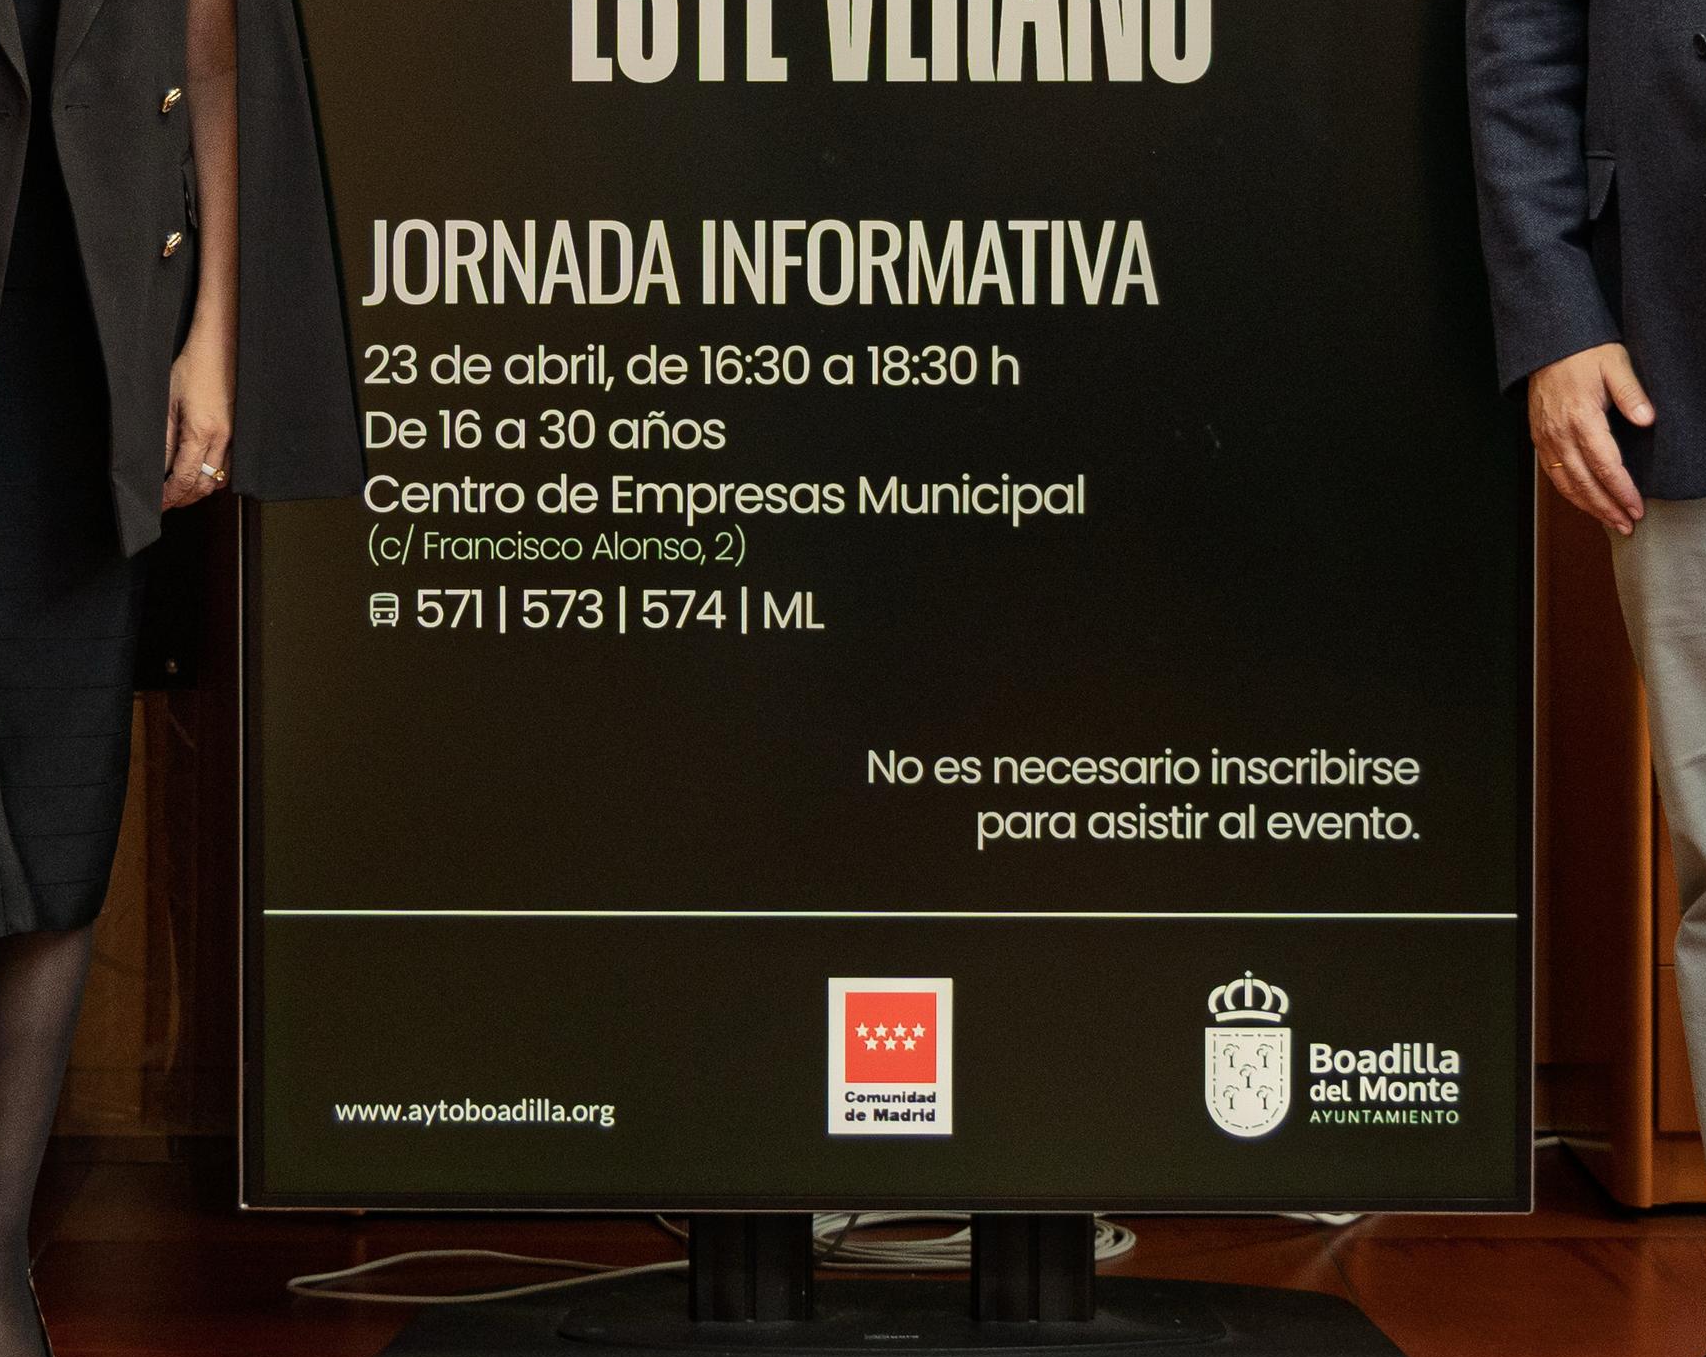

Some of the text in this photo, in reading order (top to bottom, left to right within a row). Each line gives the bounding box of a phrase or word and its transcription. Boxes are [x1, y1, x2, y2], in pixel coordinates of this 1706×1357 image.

[361, 218, 1160, 307] JORNADA INFORMATIVA
[364, 343, 1020, 392] 23 de abril, de 16:30 a 18:30 h
[365, 408, 727, 450] De 16 a 30 años
[363, 472, 1085, 528] Centro de Empresas Municipal
[368, 522, 746, 568] (c/ Francisco Alonso, 2)
[416, 588, 483, 629] 571
[522, 588, 604, 629] 573
[642, 589, 727, 630] 574
[763, 590, 826, 630] ML
[867, 747, 1421, 786] No es necesario inscribirse
[977, 802, 1421, 851] para asistir al evento.
[1309, 1042, 1460, 1075] Boadilla
[844, 1091, 936, 1103] Comunidad
[1309, 1075, 1460, 1103] del Monte
[334, 1097, 616, 1128] www.aytoboadilla.org
[844, 1108, 935, 1122] de Madrid
[1309, 1109, 1460, 1125] AYUNTAMIENTO
